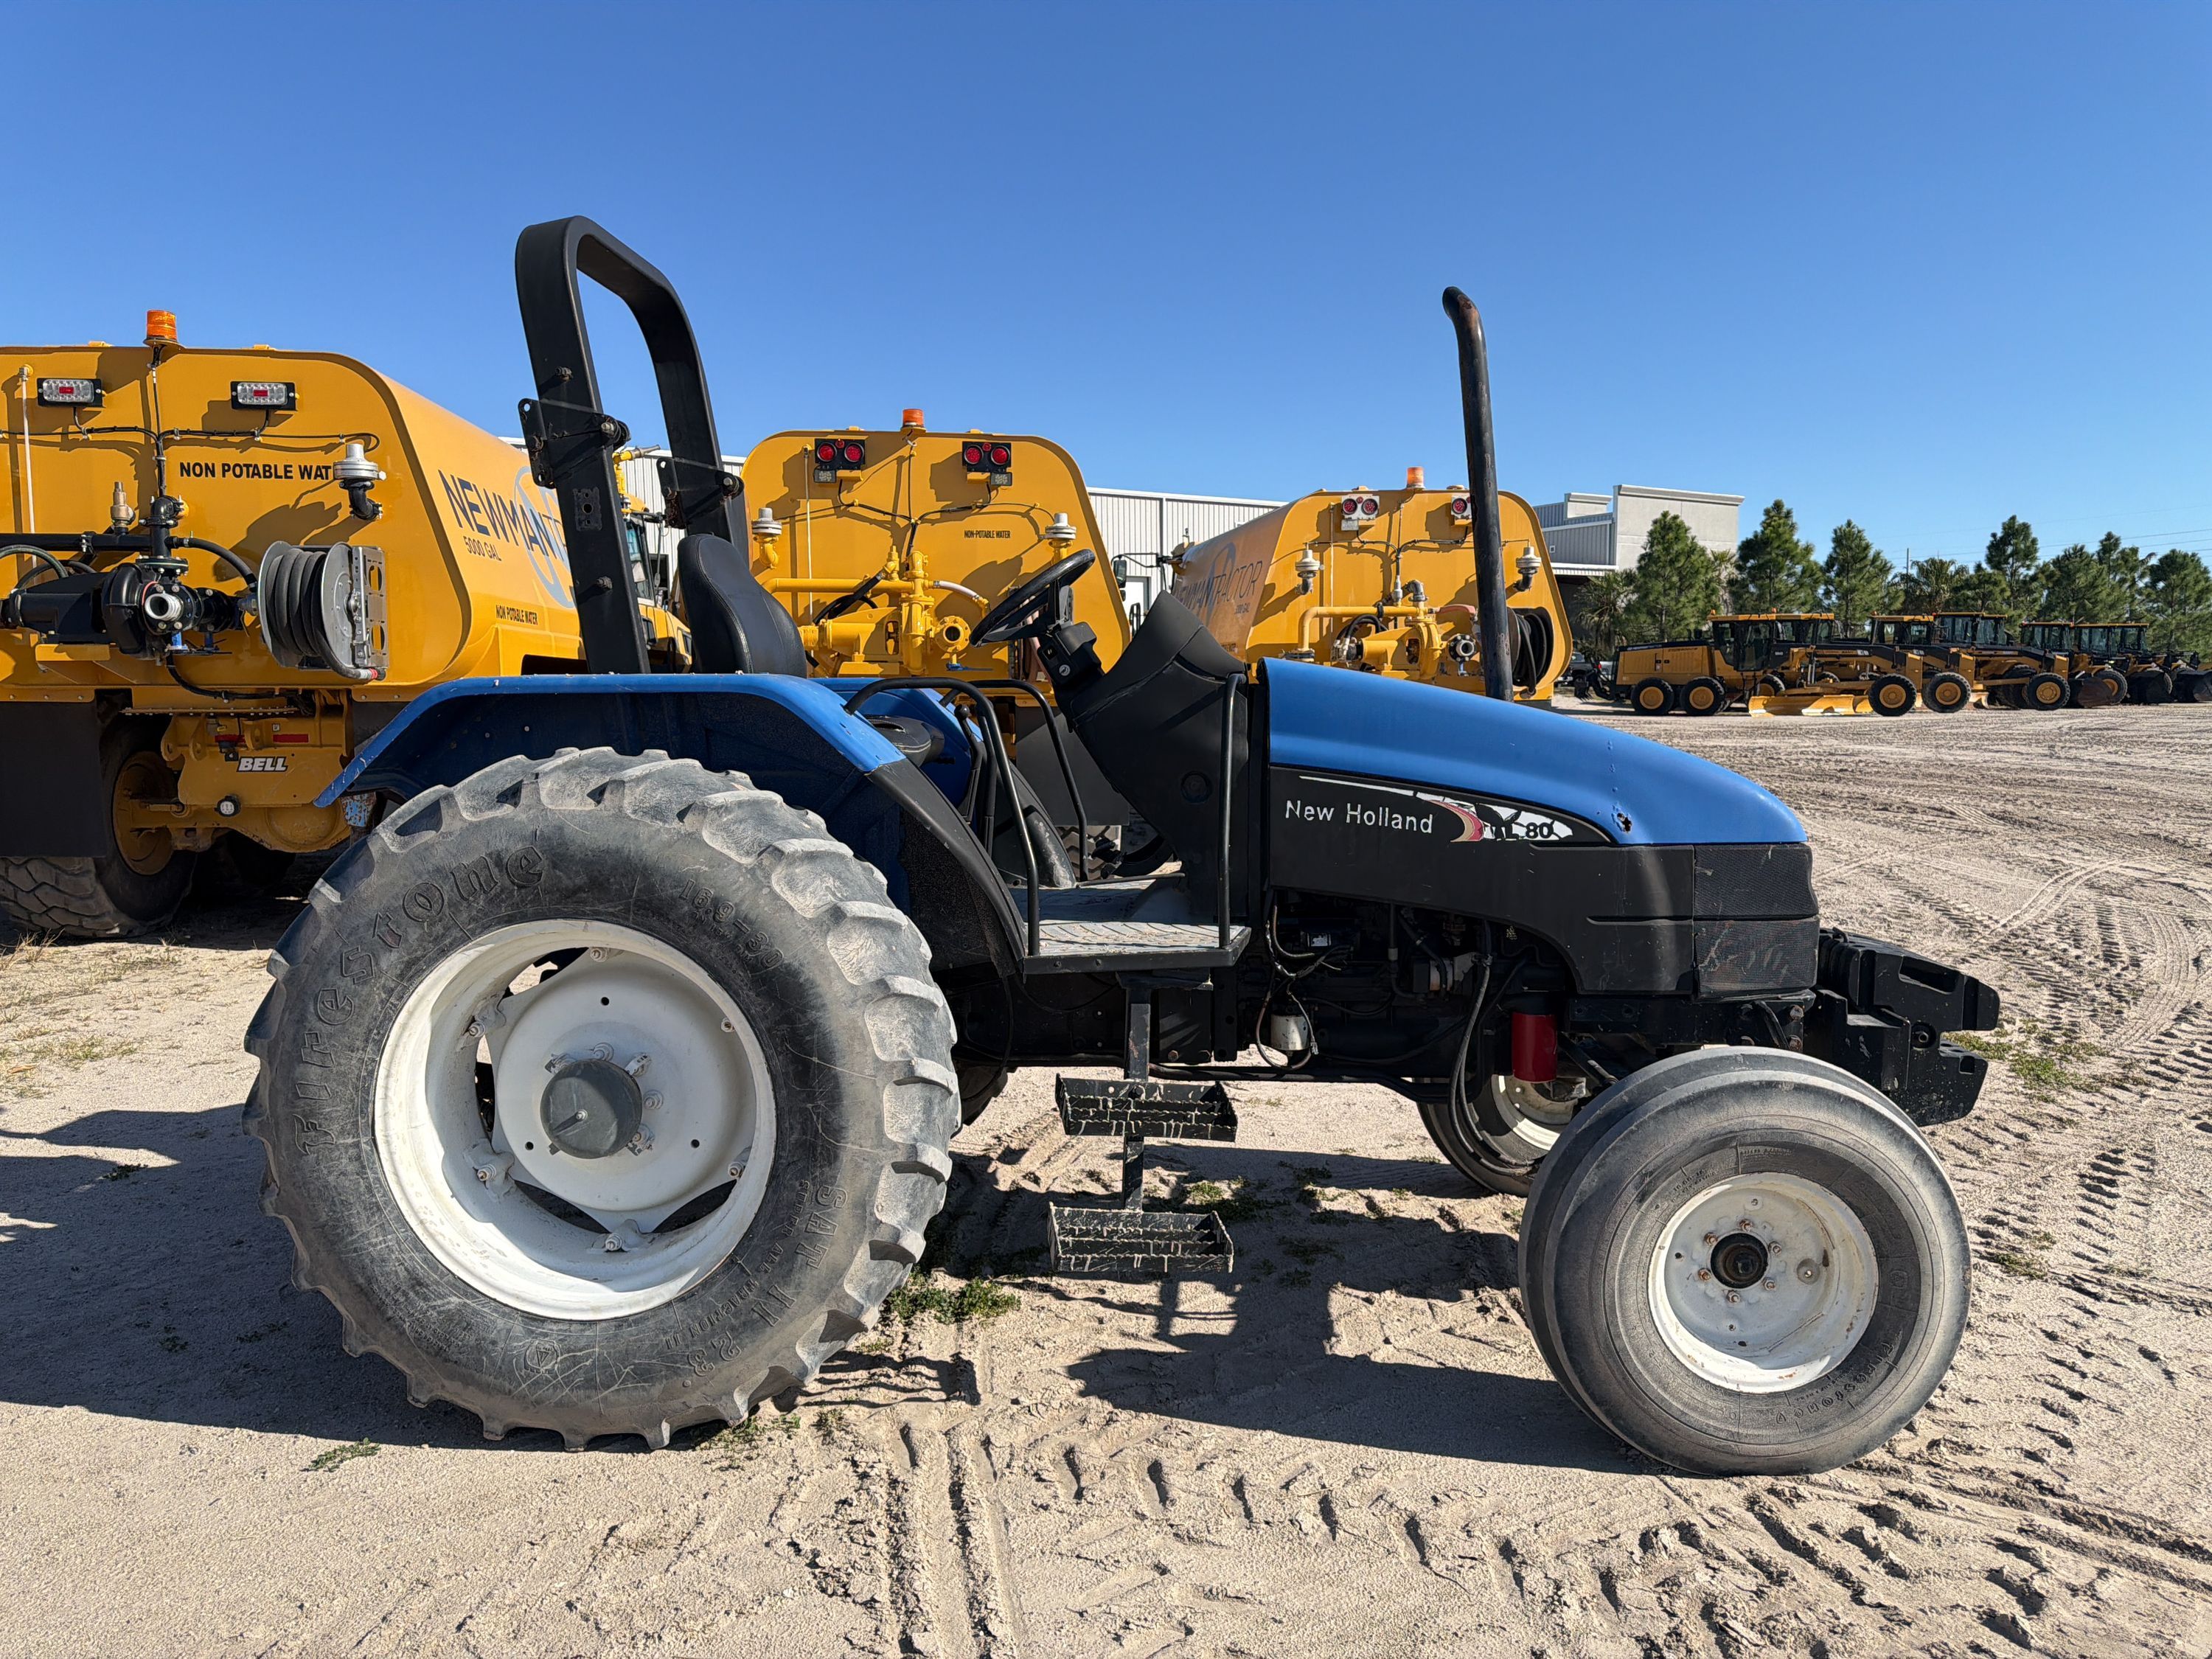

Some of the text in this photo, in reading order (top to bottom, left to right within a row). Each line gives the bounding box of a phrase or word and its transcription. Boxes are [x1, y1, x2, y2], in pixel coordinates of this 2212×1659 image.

[180, 462, 334, 481] NON POTABLE WAT
[463, 535, 502, 562] 5000 GAL
[995, 530, 1011, 539] WATER
[495, 604, 538, 626] NON POTABLE WATER
[237, 757, 288, 772] BELL
[1285, 800, 1433, 834] New Holland
[292, 845, 544, 1156] Firestone
[782, 1179, 810, 1237] SUPER
[794, 1185, 848, 1270] SAT
[759, 1242, 784, 1275] ALL
[689, 1278, 759, 1339] TRACTION
[751, 1284, 796, 1327] II
[1793, 1340, 1894, 1419] Firestone
